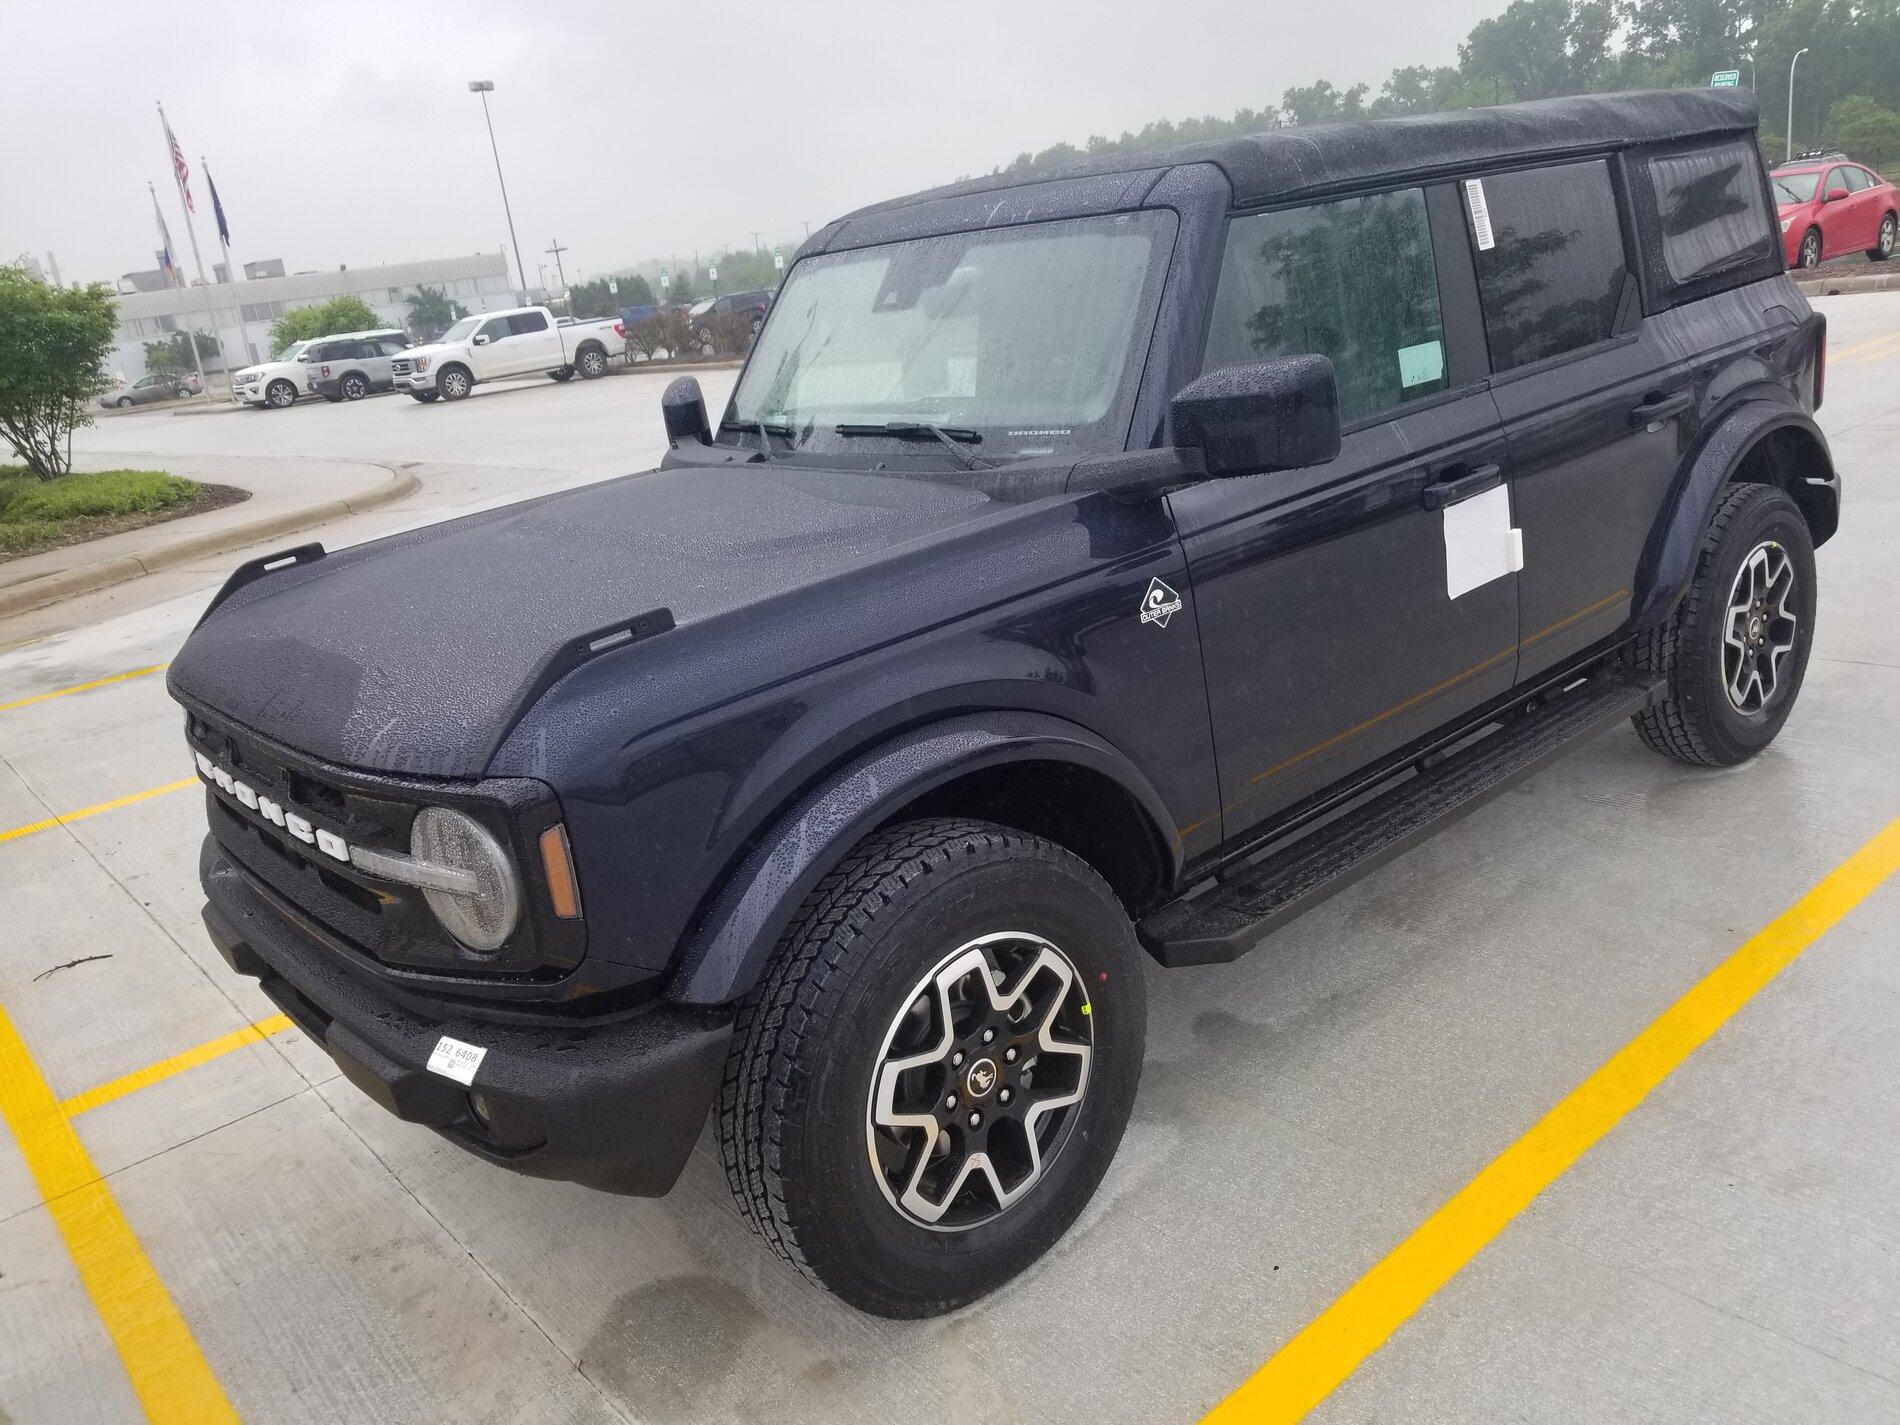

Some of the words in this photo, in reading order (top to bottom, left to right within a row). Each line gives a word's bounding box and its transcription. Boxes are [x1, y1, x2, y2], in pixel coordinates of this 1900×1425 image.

[1714, 73, 1737, 81] RESERVED
[1142, 609, 1161, 622] OUTER
[1162, 601, 1181, 614] BANKS
[195, 750, 349, 862] BRONCO
[436, 1042, 453, 1054] 152
[455, 1048, 479, 1062] 6408
